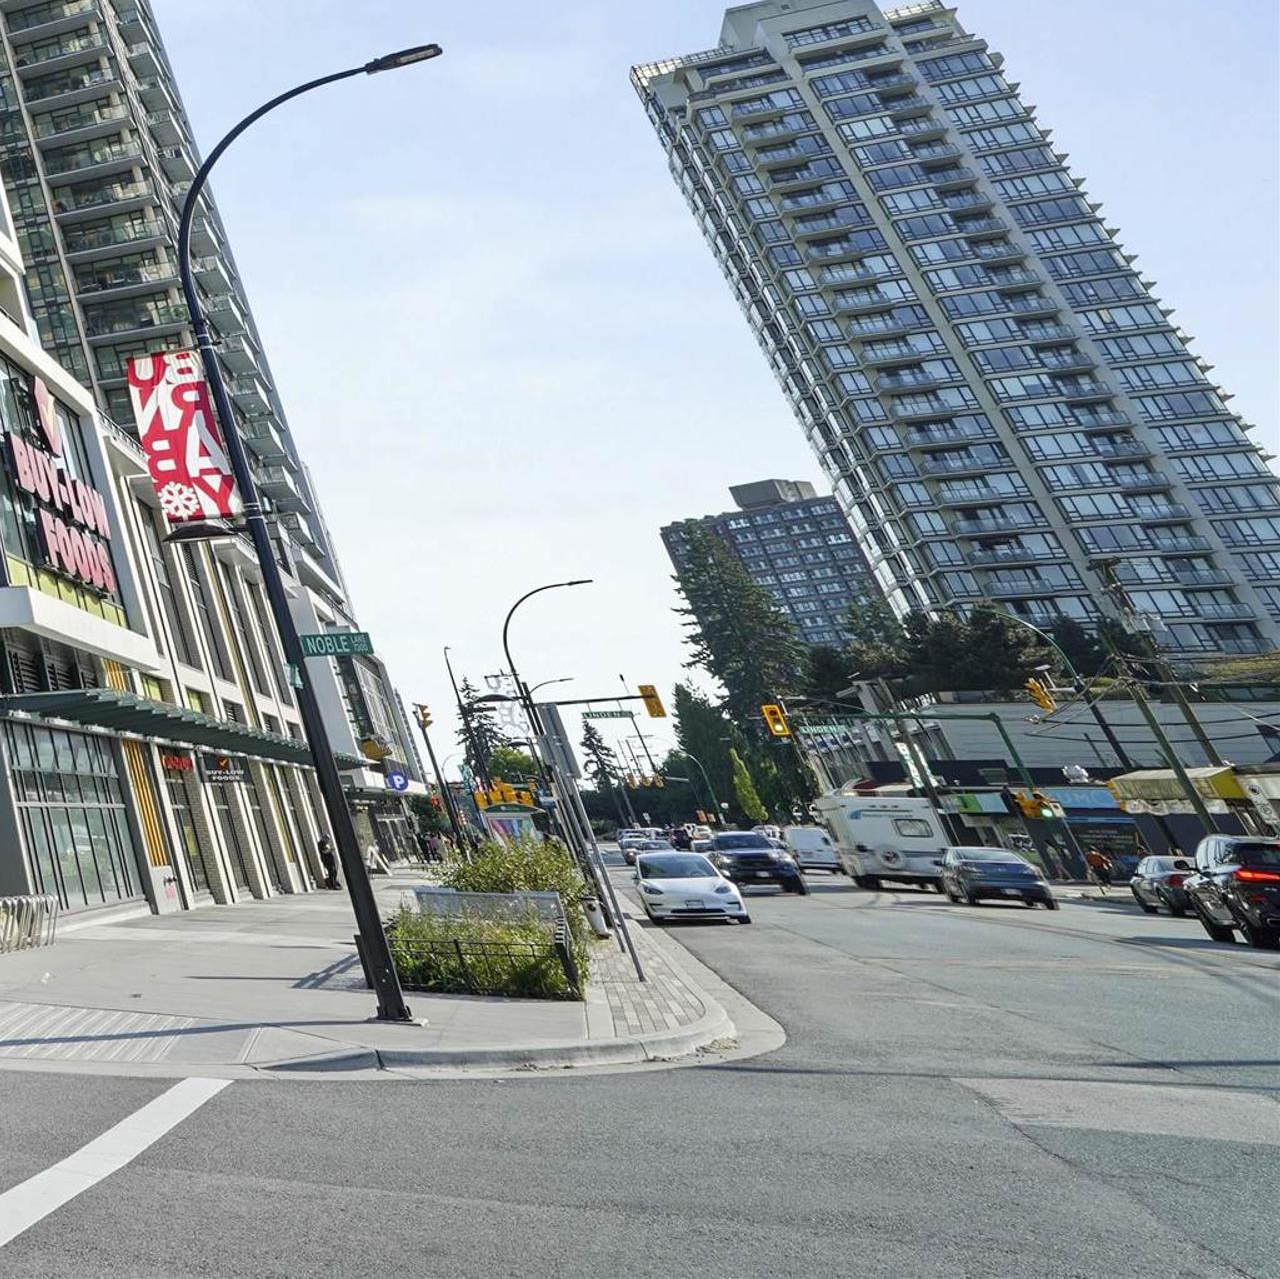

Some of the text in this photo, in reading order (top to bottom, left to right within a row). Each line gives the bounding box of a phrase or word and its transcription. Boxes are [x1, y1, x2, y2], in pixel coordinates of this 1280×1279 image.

[10, 432, 112, 540] BUY-LOW
[39, 508, 116, 593] FOODS
[306, 635, 350, 654] NOBLE
[392, 774, 405, 790] P
